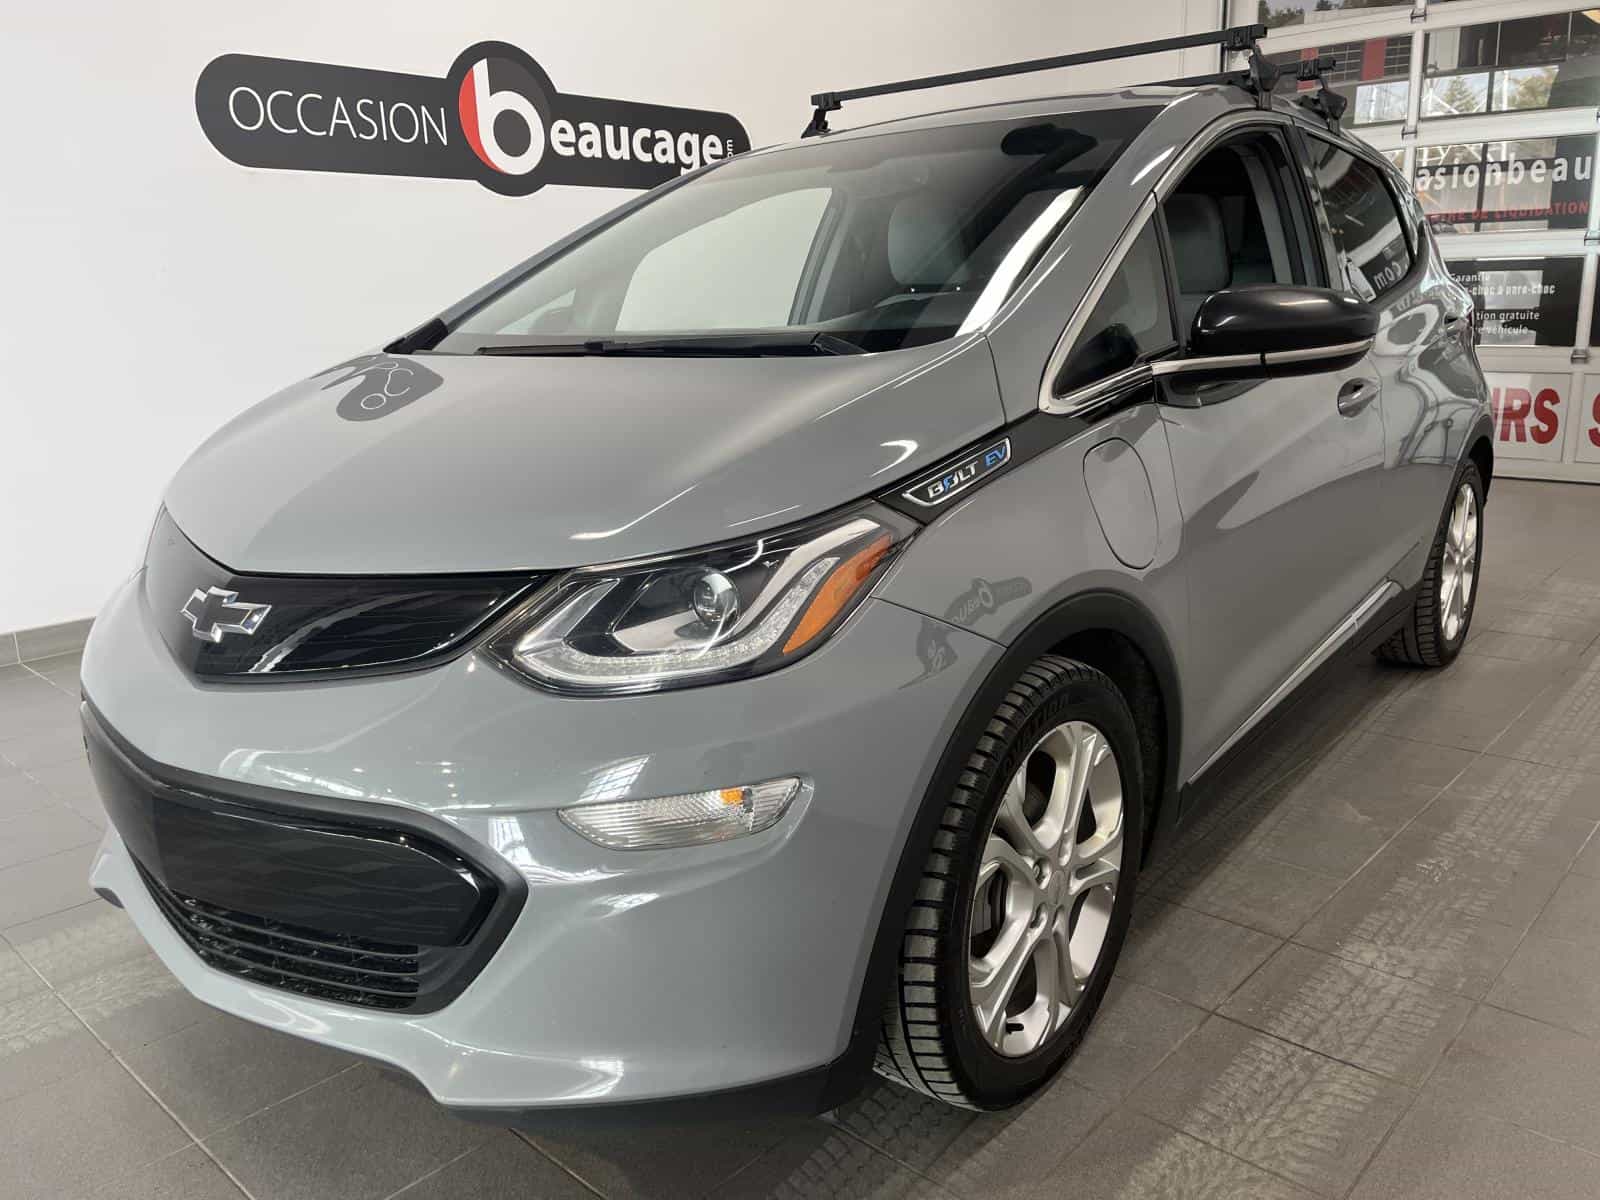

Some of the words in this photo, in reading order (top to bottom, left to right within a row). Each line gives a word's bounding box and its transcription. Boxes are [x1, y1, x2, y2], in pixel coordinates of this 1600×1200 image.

[228, 86, 448, 146] OCCASION
[1495, 200, 1590, 221] LIQUIDATION
[1499, 311, 1541, 323] gratuite
[927, 460, 979, 499] BOLT
[985, 446, 1007, 467] EV
